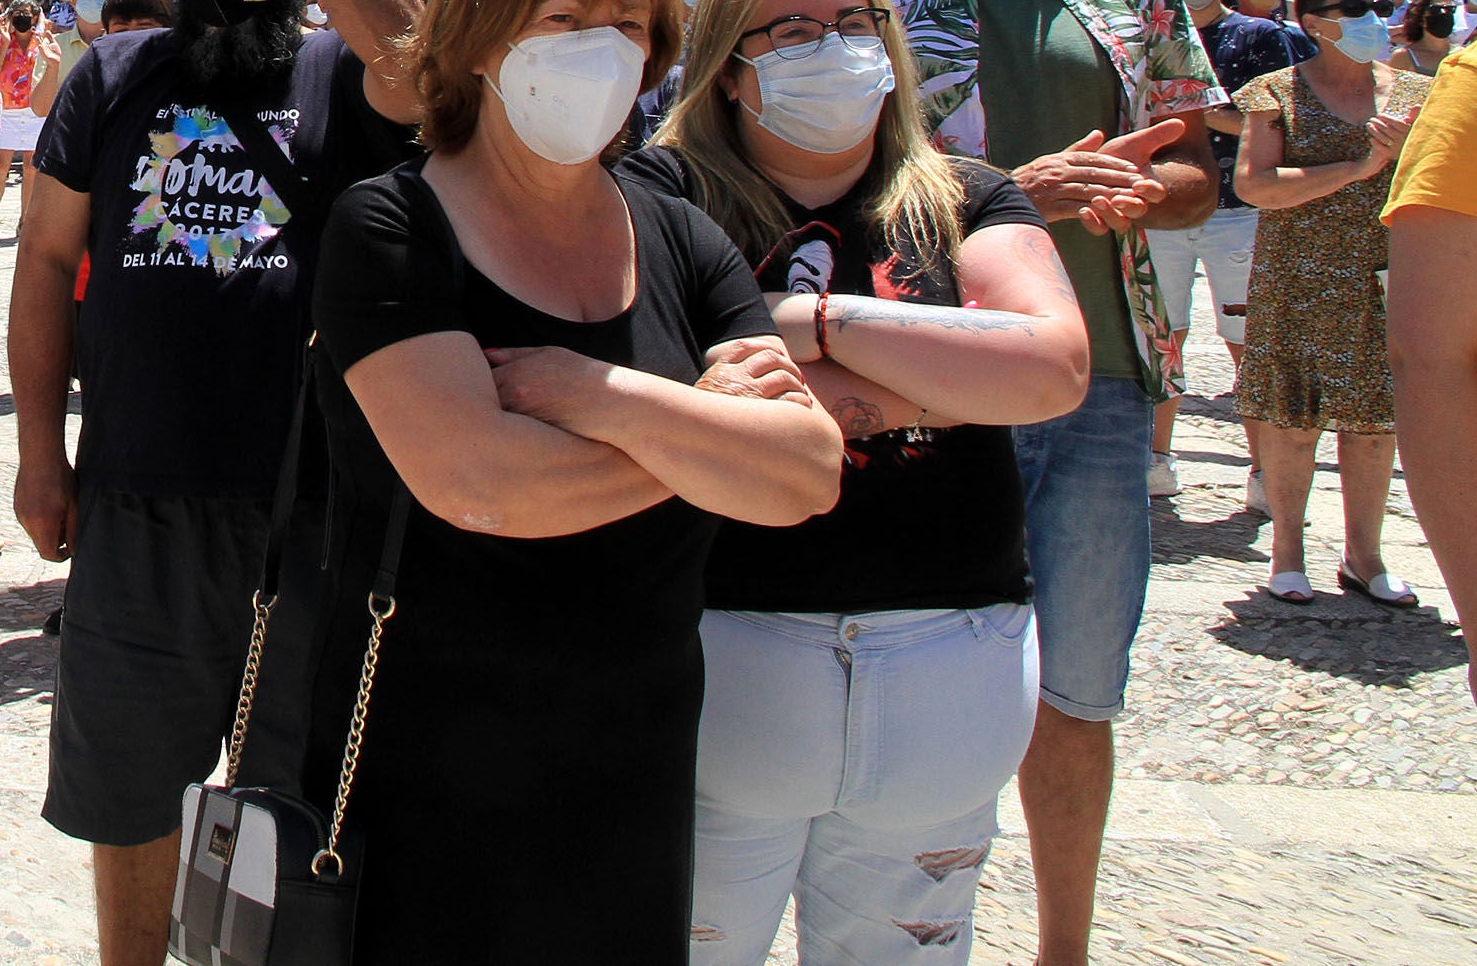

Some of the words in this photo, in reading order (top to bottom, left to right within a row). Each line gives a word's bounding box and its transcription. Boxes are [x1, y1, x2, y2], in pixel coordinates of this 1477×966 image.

[257, 108, 299, 122] UNDO
[123, 254, 146, 268] DEL
[150, 253, 161, 266] 11
[164, 253, 185, 265] AL
[190, 255, 209, 268] 14
[213, 257, 237, 271] DE
[239, 255, 289, 270] MAYO
